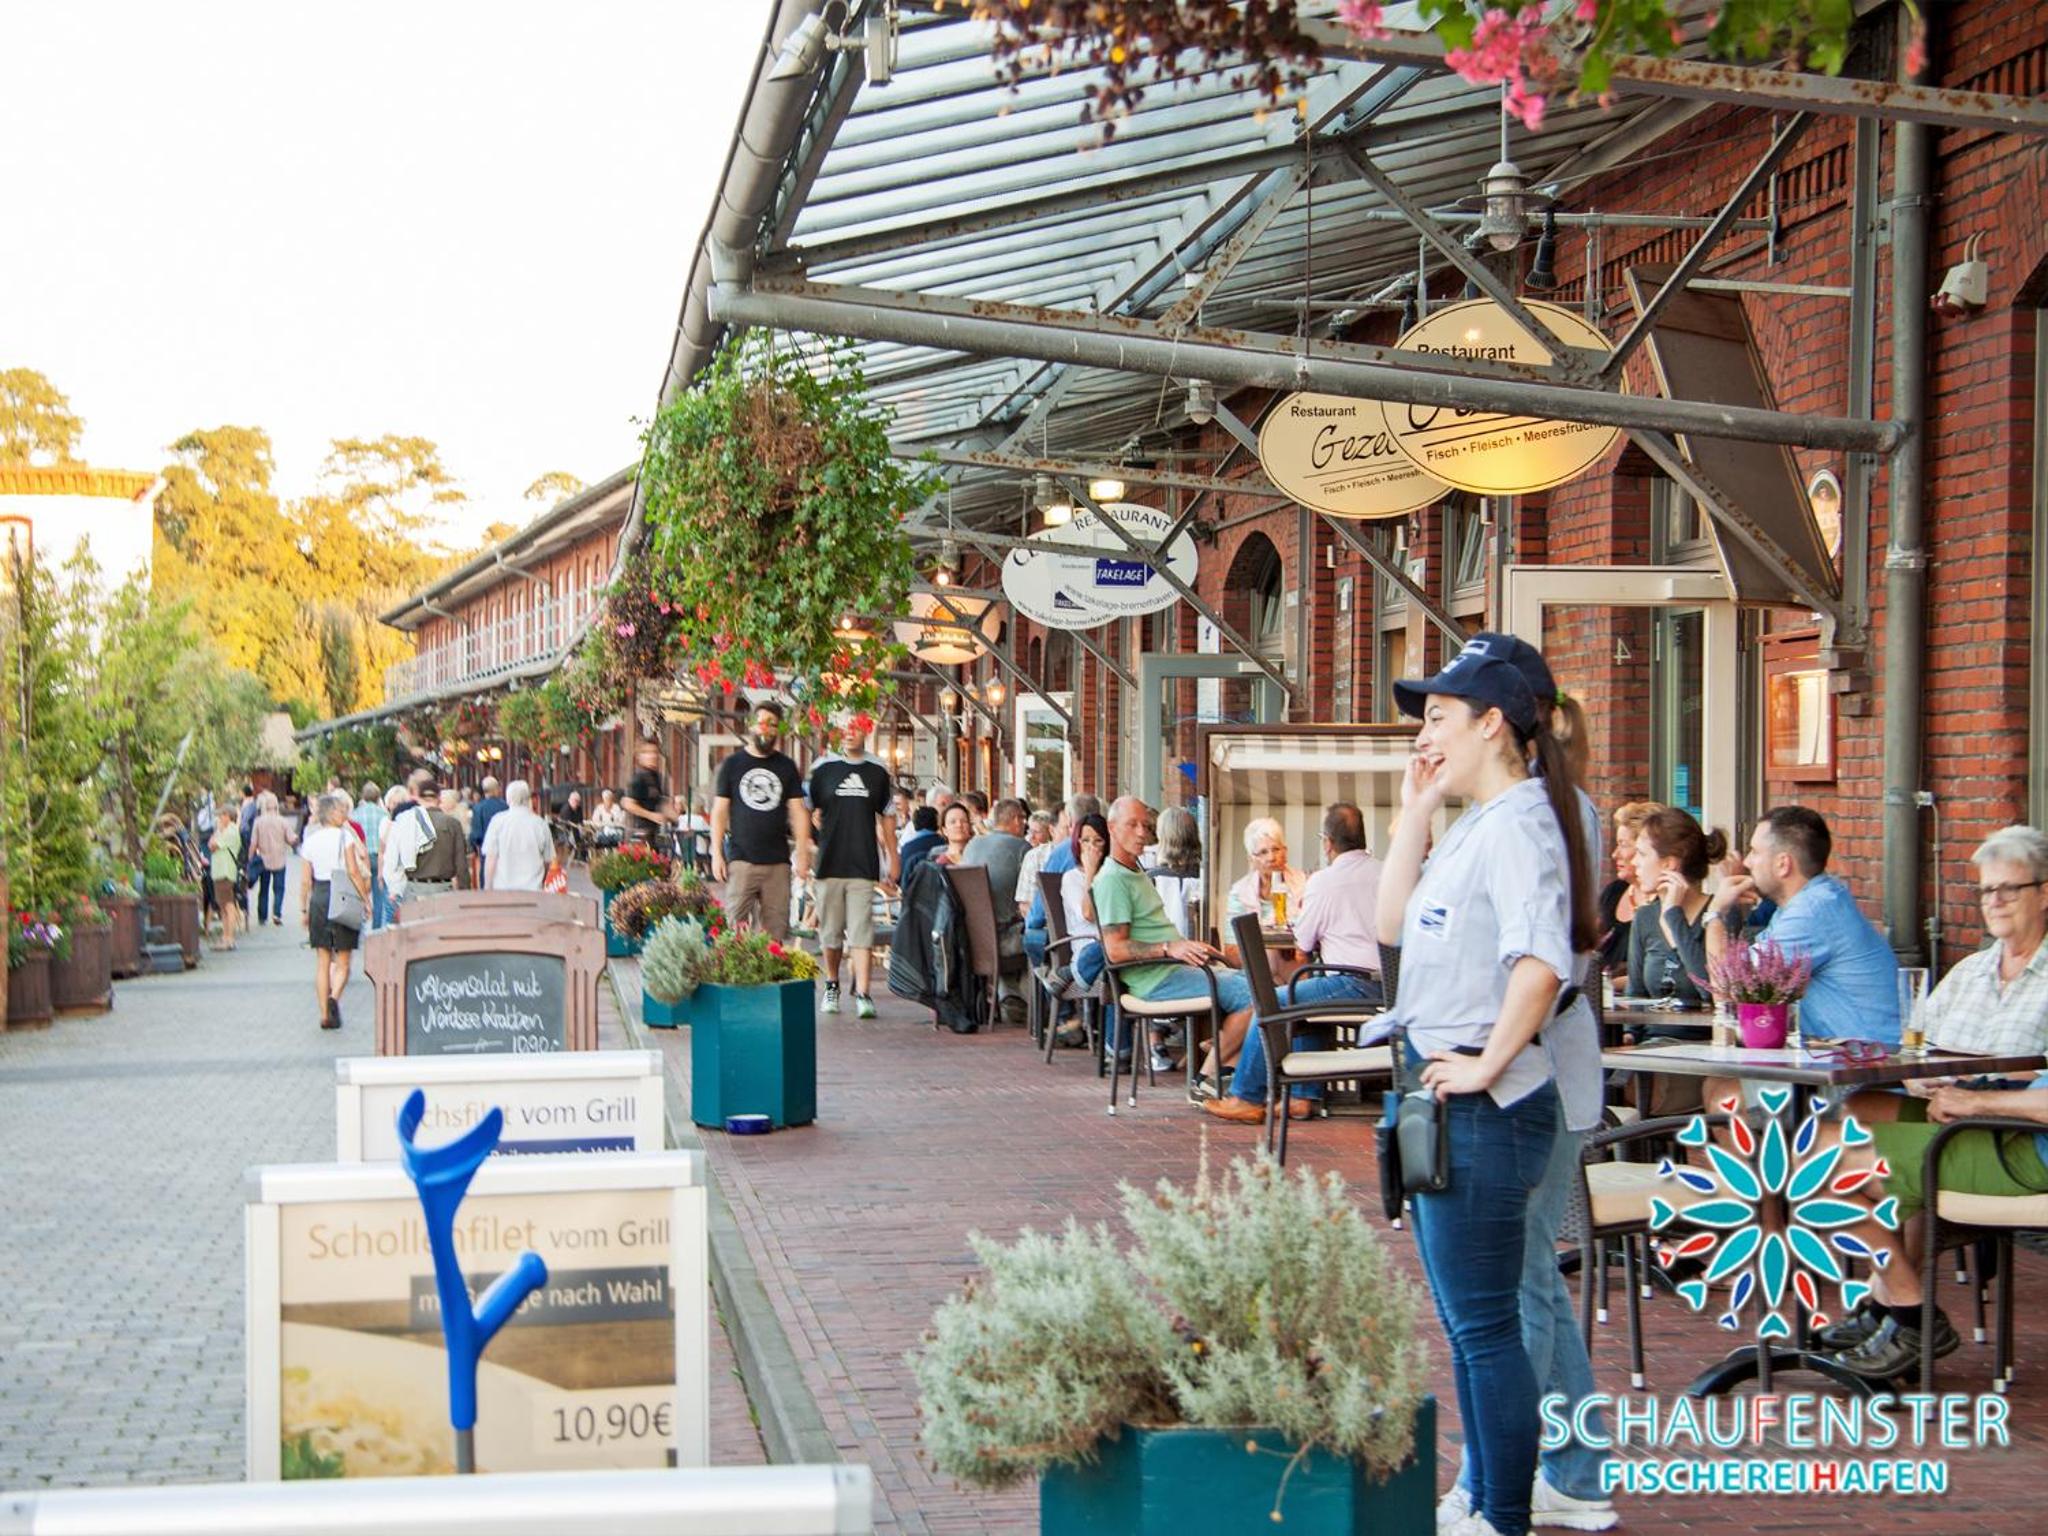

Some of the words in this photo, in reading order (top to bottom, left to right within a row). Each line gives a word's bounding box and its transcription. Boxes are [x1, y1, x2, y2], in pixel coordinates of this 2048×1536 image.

[1291, 405, 1356, 417] Restaurant
[1426, 447, 1459, 463] Fisch
[1469, 435, 1513, 454] Fleisch
[1323, 483, 1346, 495] Fisch
[1352, 477, 1381, 489] Fleisch
[1386, 468, 1424, 482] Meeresfr
[1074, 509, 1174, 533] RESAURANT
[1096, 568, 1144, 581] TAKELAGE
[1613, 637, 1632, 665] 4
[520, 1106, 577, 1125] vom
[586, 1096, 636, 1123] Grill
[549, 1227, 608, 1249] vom
[617, 1217, 670, 1247] Grill
[550, 1282, 601, 1306] nach
[606, 1279, 663, 1304] Wahl
[554, 1402, 672, 1446] 10,90€
